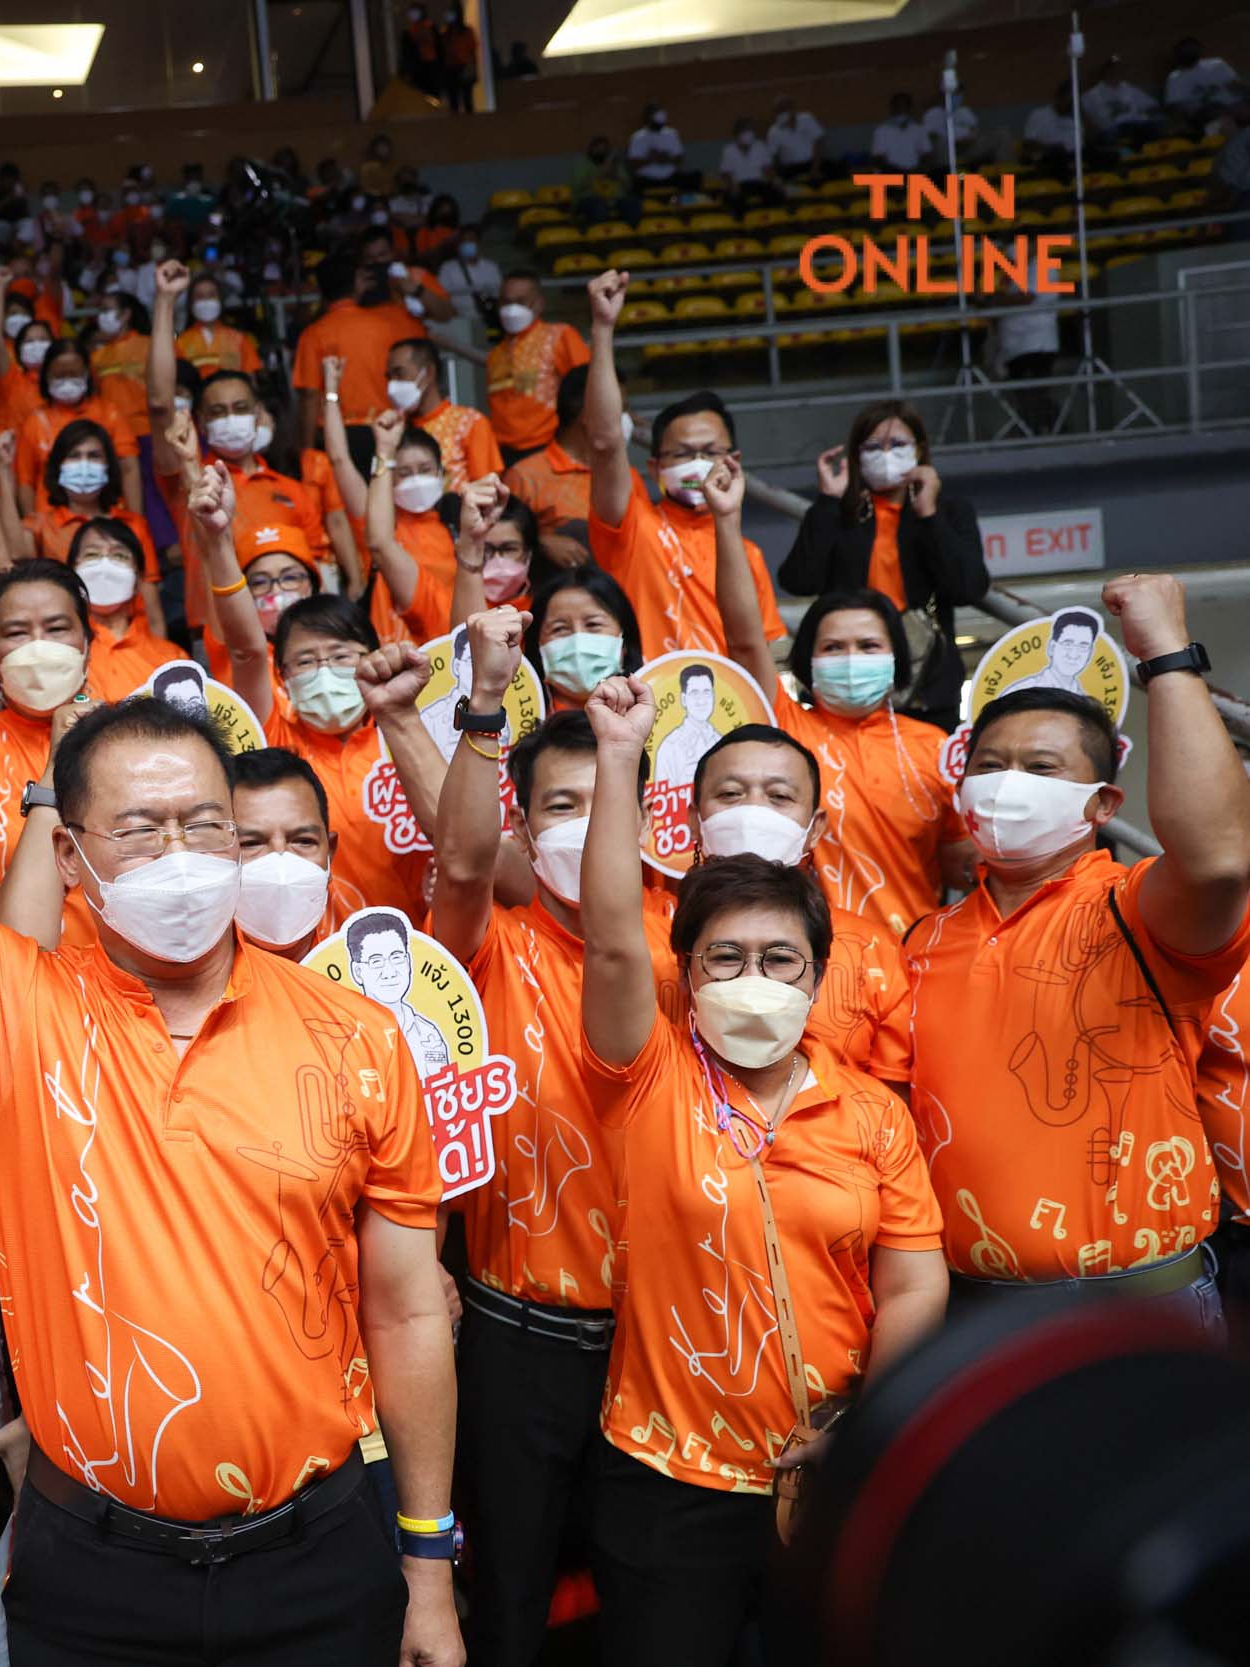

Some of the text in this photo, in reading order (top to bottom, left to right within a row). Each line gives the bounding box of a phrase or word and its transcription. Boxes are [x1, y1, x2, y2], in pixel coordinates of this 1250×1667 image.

[1024, 522, 1092, 558] EXIT
[1002, 635, 1042, 669] 1300
[420, 960, 475, 1056] แจ้ง 1300
